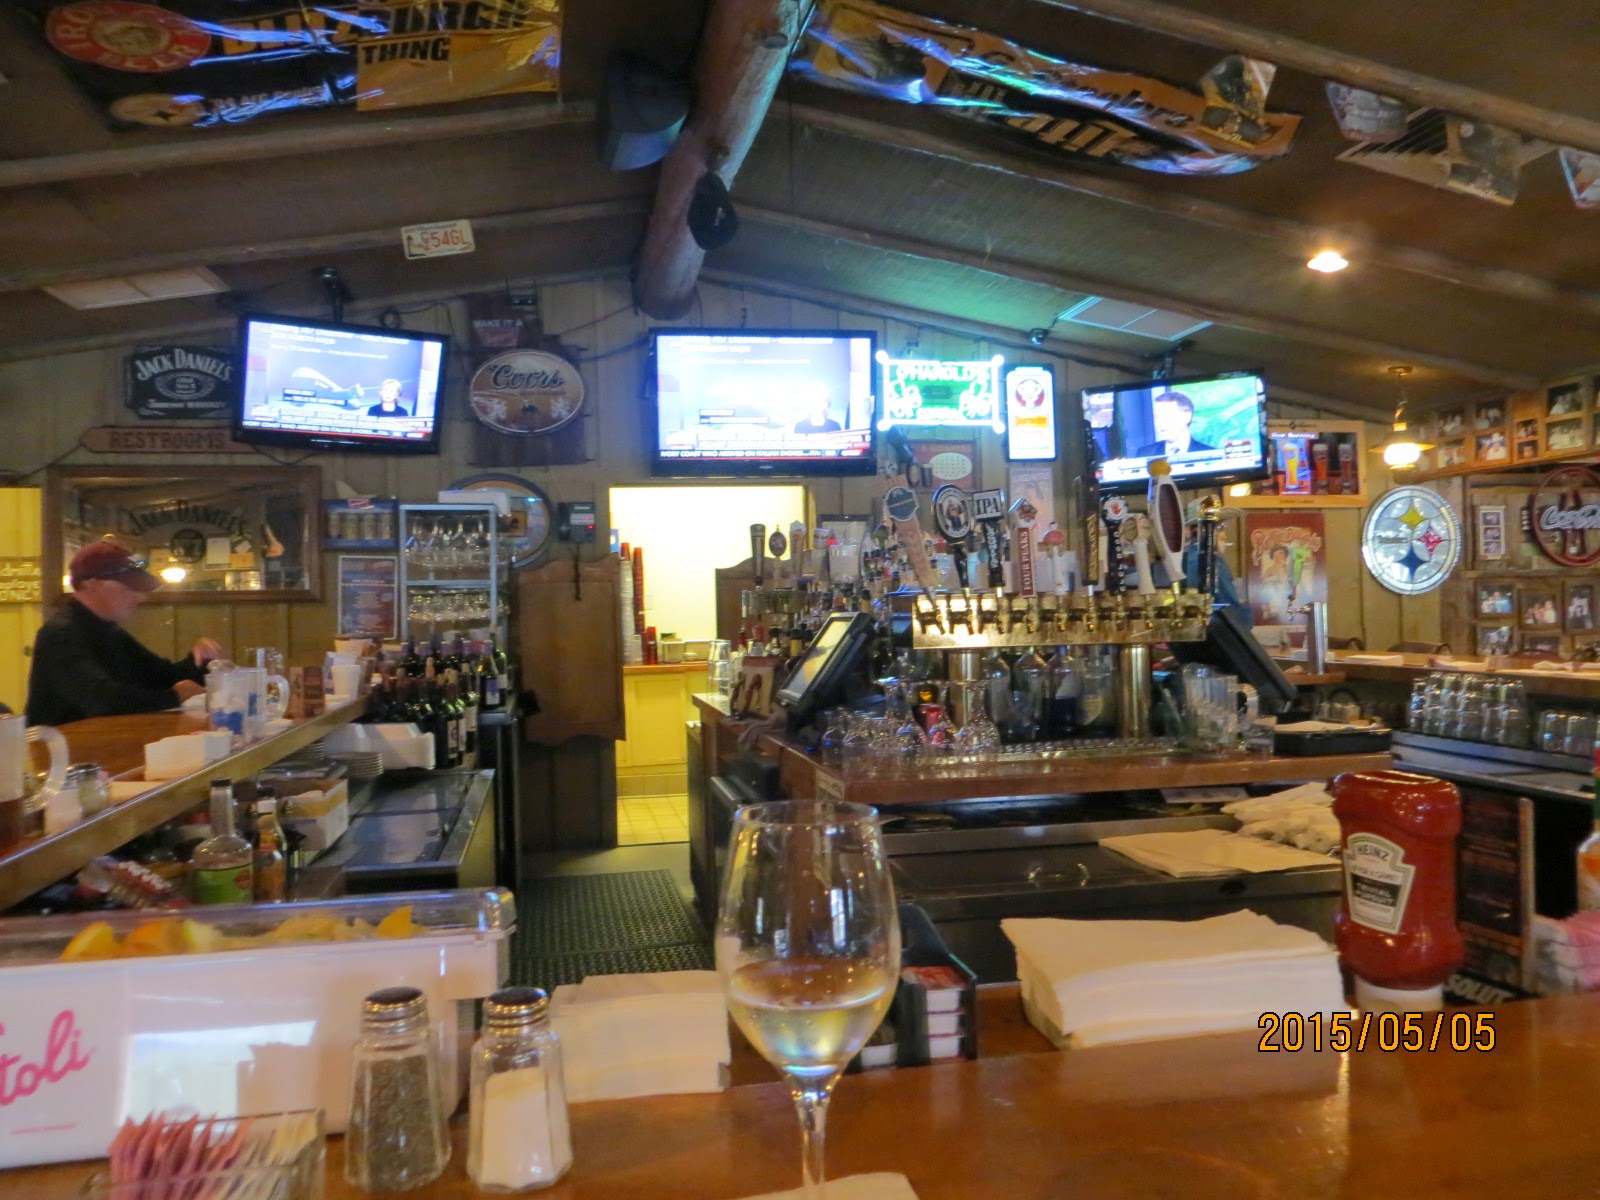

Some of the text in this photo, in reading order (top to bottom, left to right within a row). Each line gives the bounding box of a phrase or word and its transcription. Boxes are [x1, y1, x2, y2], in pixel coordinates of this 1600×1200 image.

[363, 37, 450, 64] THING
[135, 354, 175, 381] JACK
[489, 364, 565, 390] Coors
[109, 431, 226, 449] RESTROOMS
[976, 496, 1000, 516] IPA
[1019, 530, 1032, 592] FOUR PEAKS
[1354, 843, 1391, 862] HEINZ
[0, 1008, 98, 1107] toli
